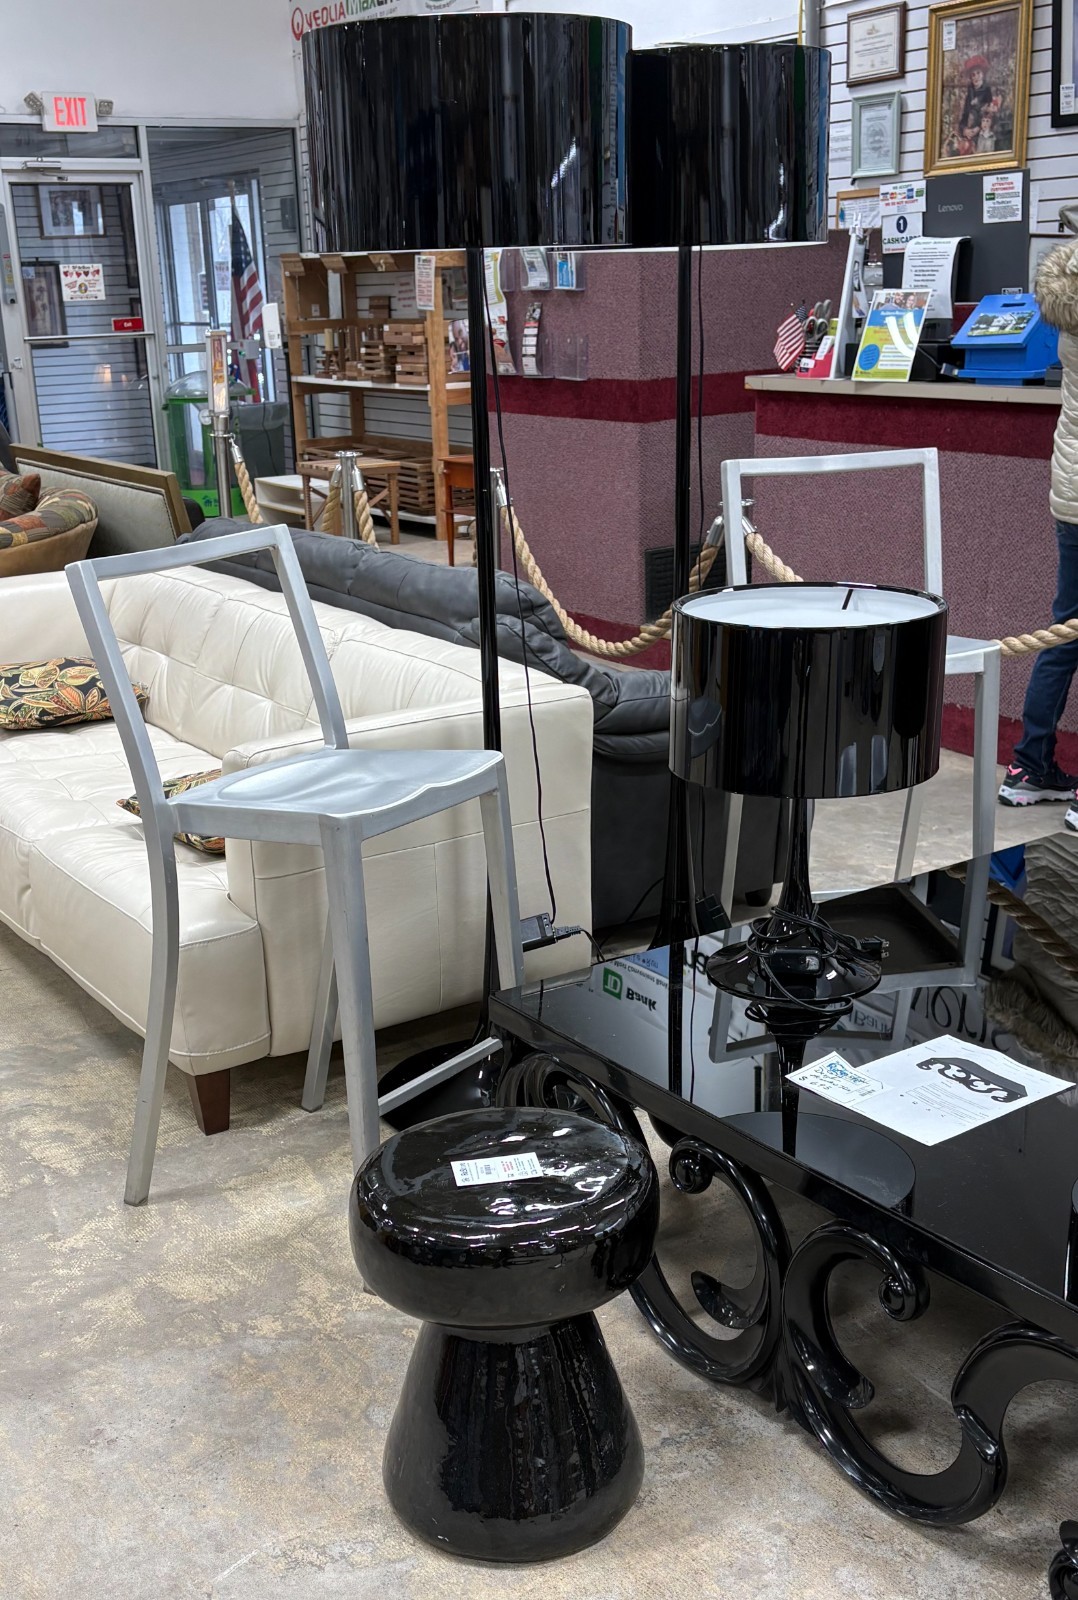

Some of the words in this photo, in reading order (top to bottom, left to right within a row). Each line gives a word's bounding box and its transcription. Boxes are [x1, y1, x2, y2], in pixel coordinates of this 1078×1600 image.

[305, 1, 347, 29] VEOLIA
[53, 97, 87, 126] EXIT
[938, 204, 964, 213] Lenovo
